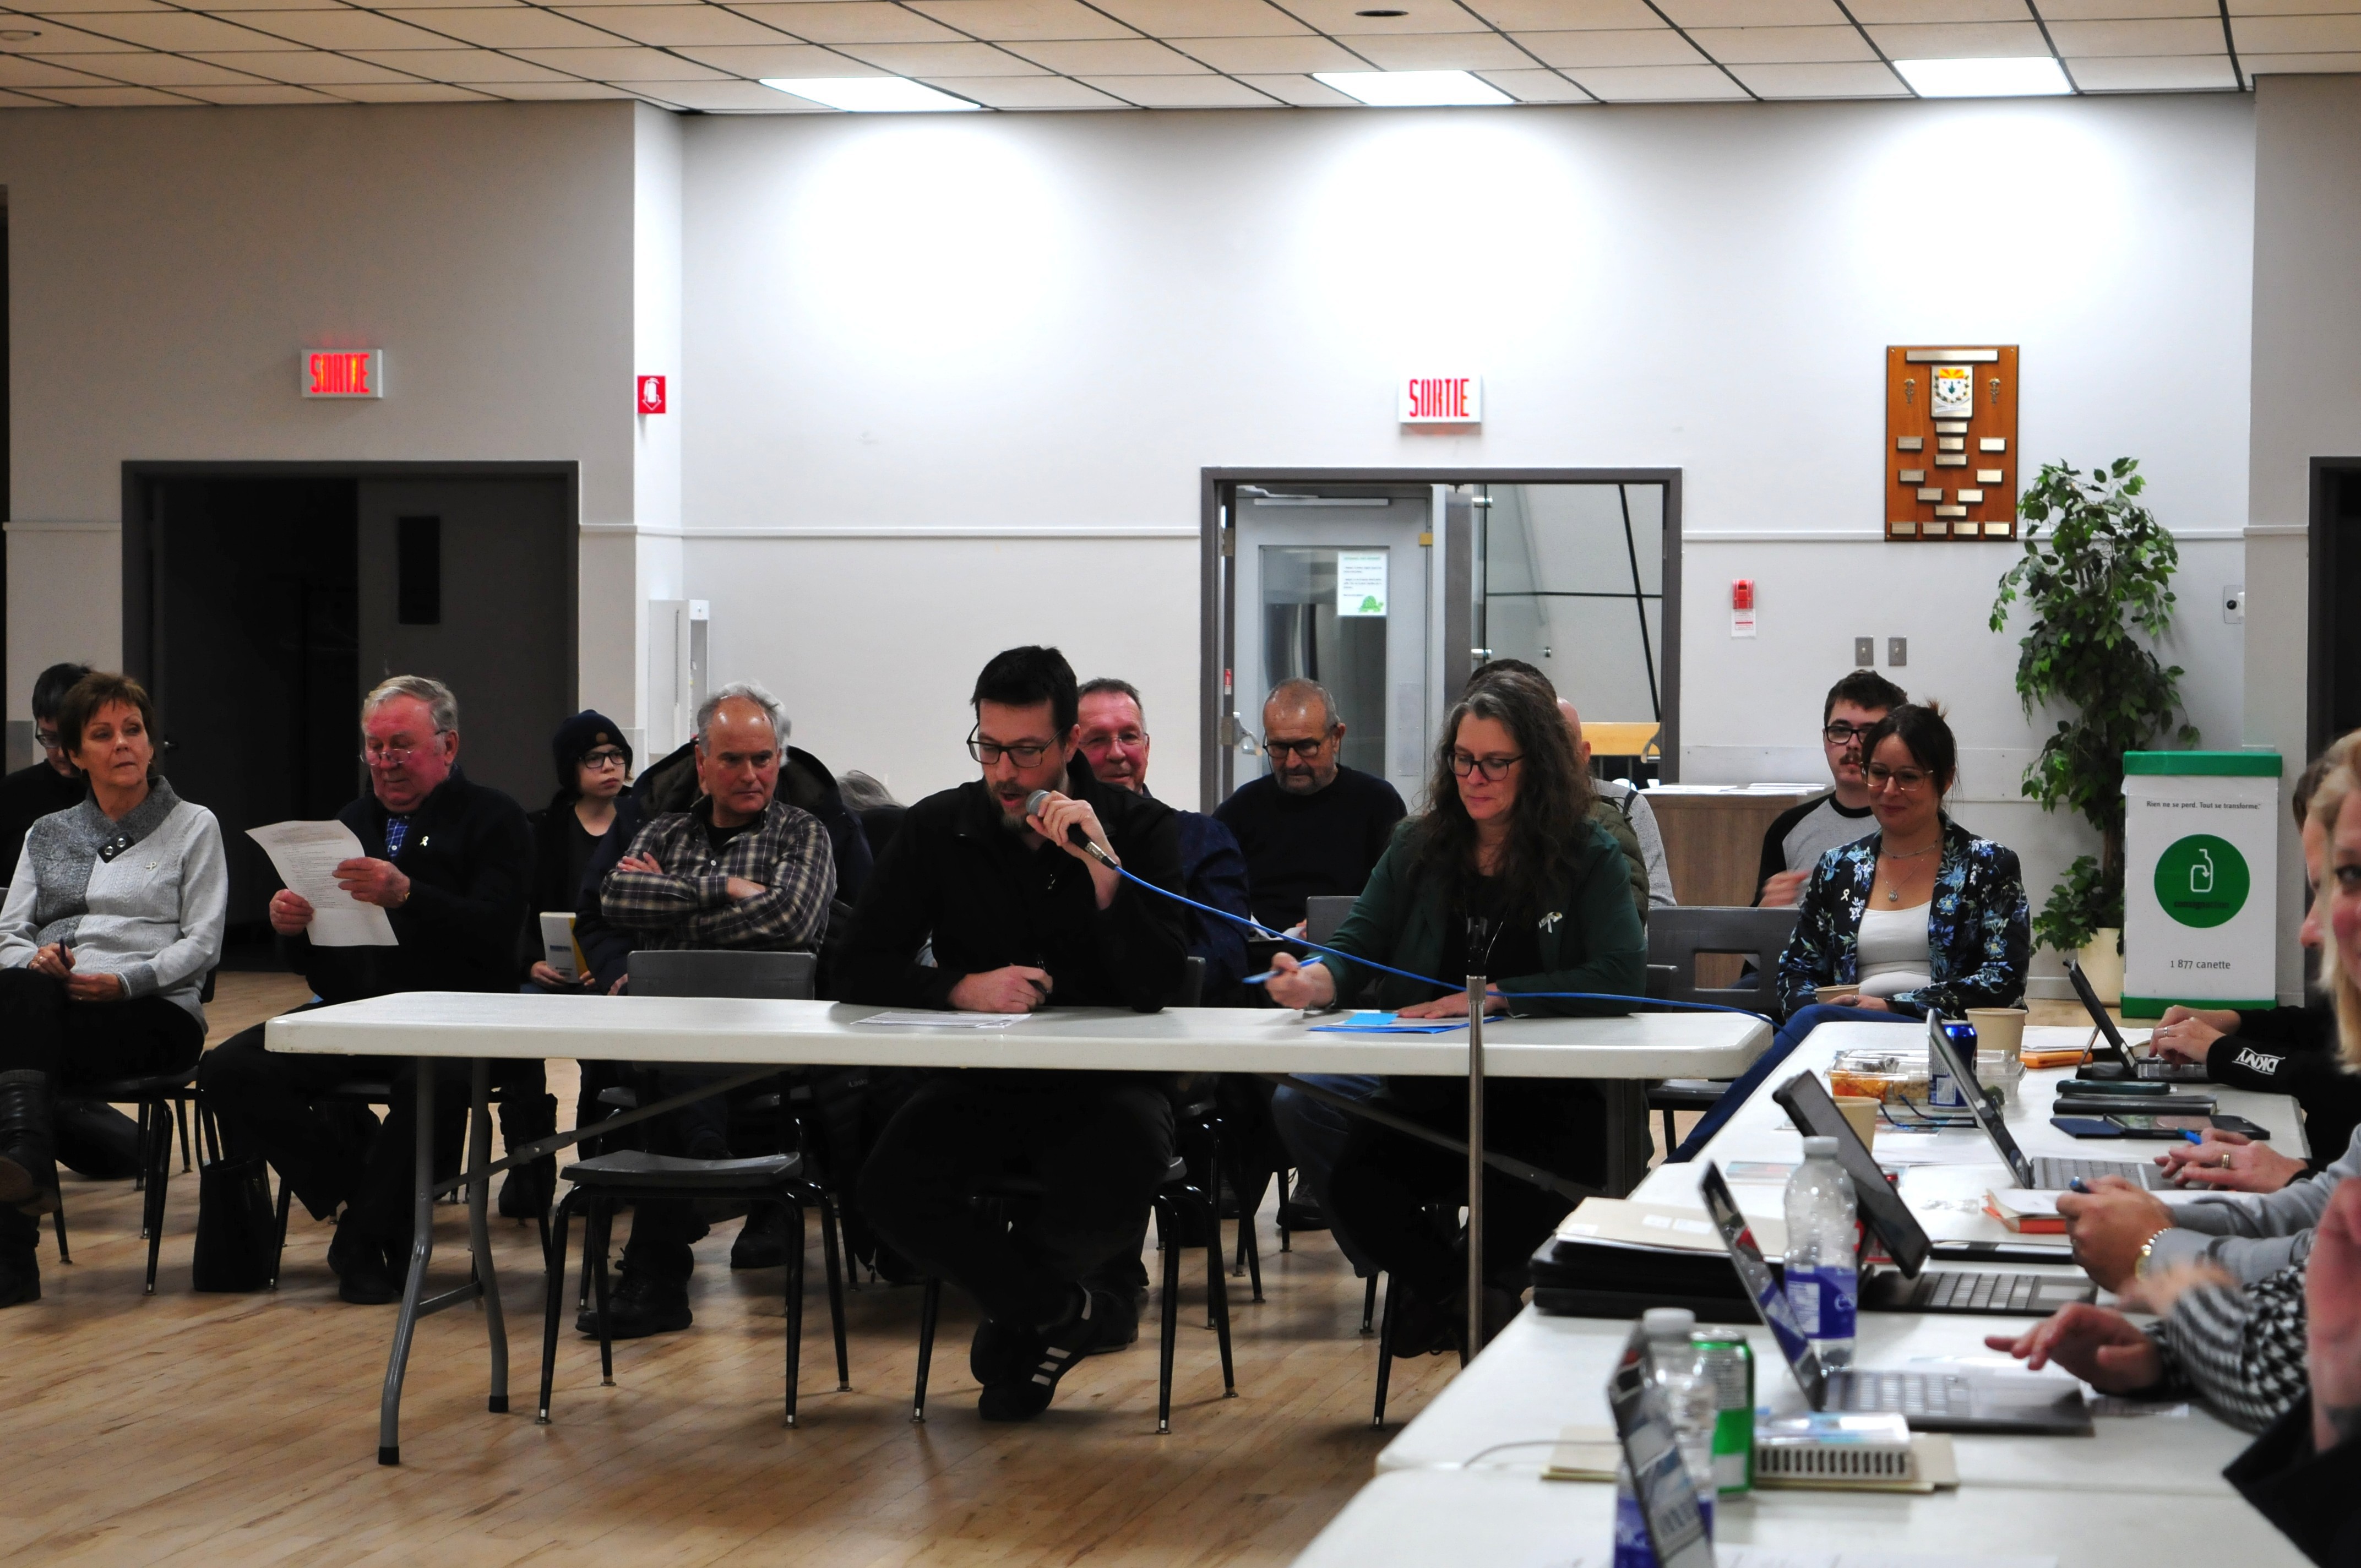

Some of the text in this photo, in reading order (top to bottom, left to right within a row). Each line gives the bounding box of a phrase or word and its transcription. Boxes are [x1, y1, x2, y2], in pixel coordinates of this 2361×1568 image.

[309, 352, 370, 393] SORTIE
[1409, 378, 1470, 417] SORTIE
[2178, 959, 2193, 969] 877
[2196, 961, 2231, 969] canette
[2235, 1049, 2279, 1073] DKNY
